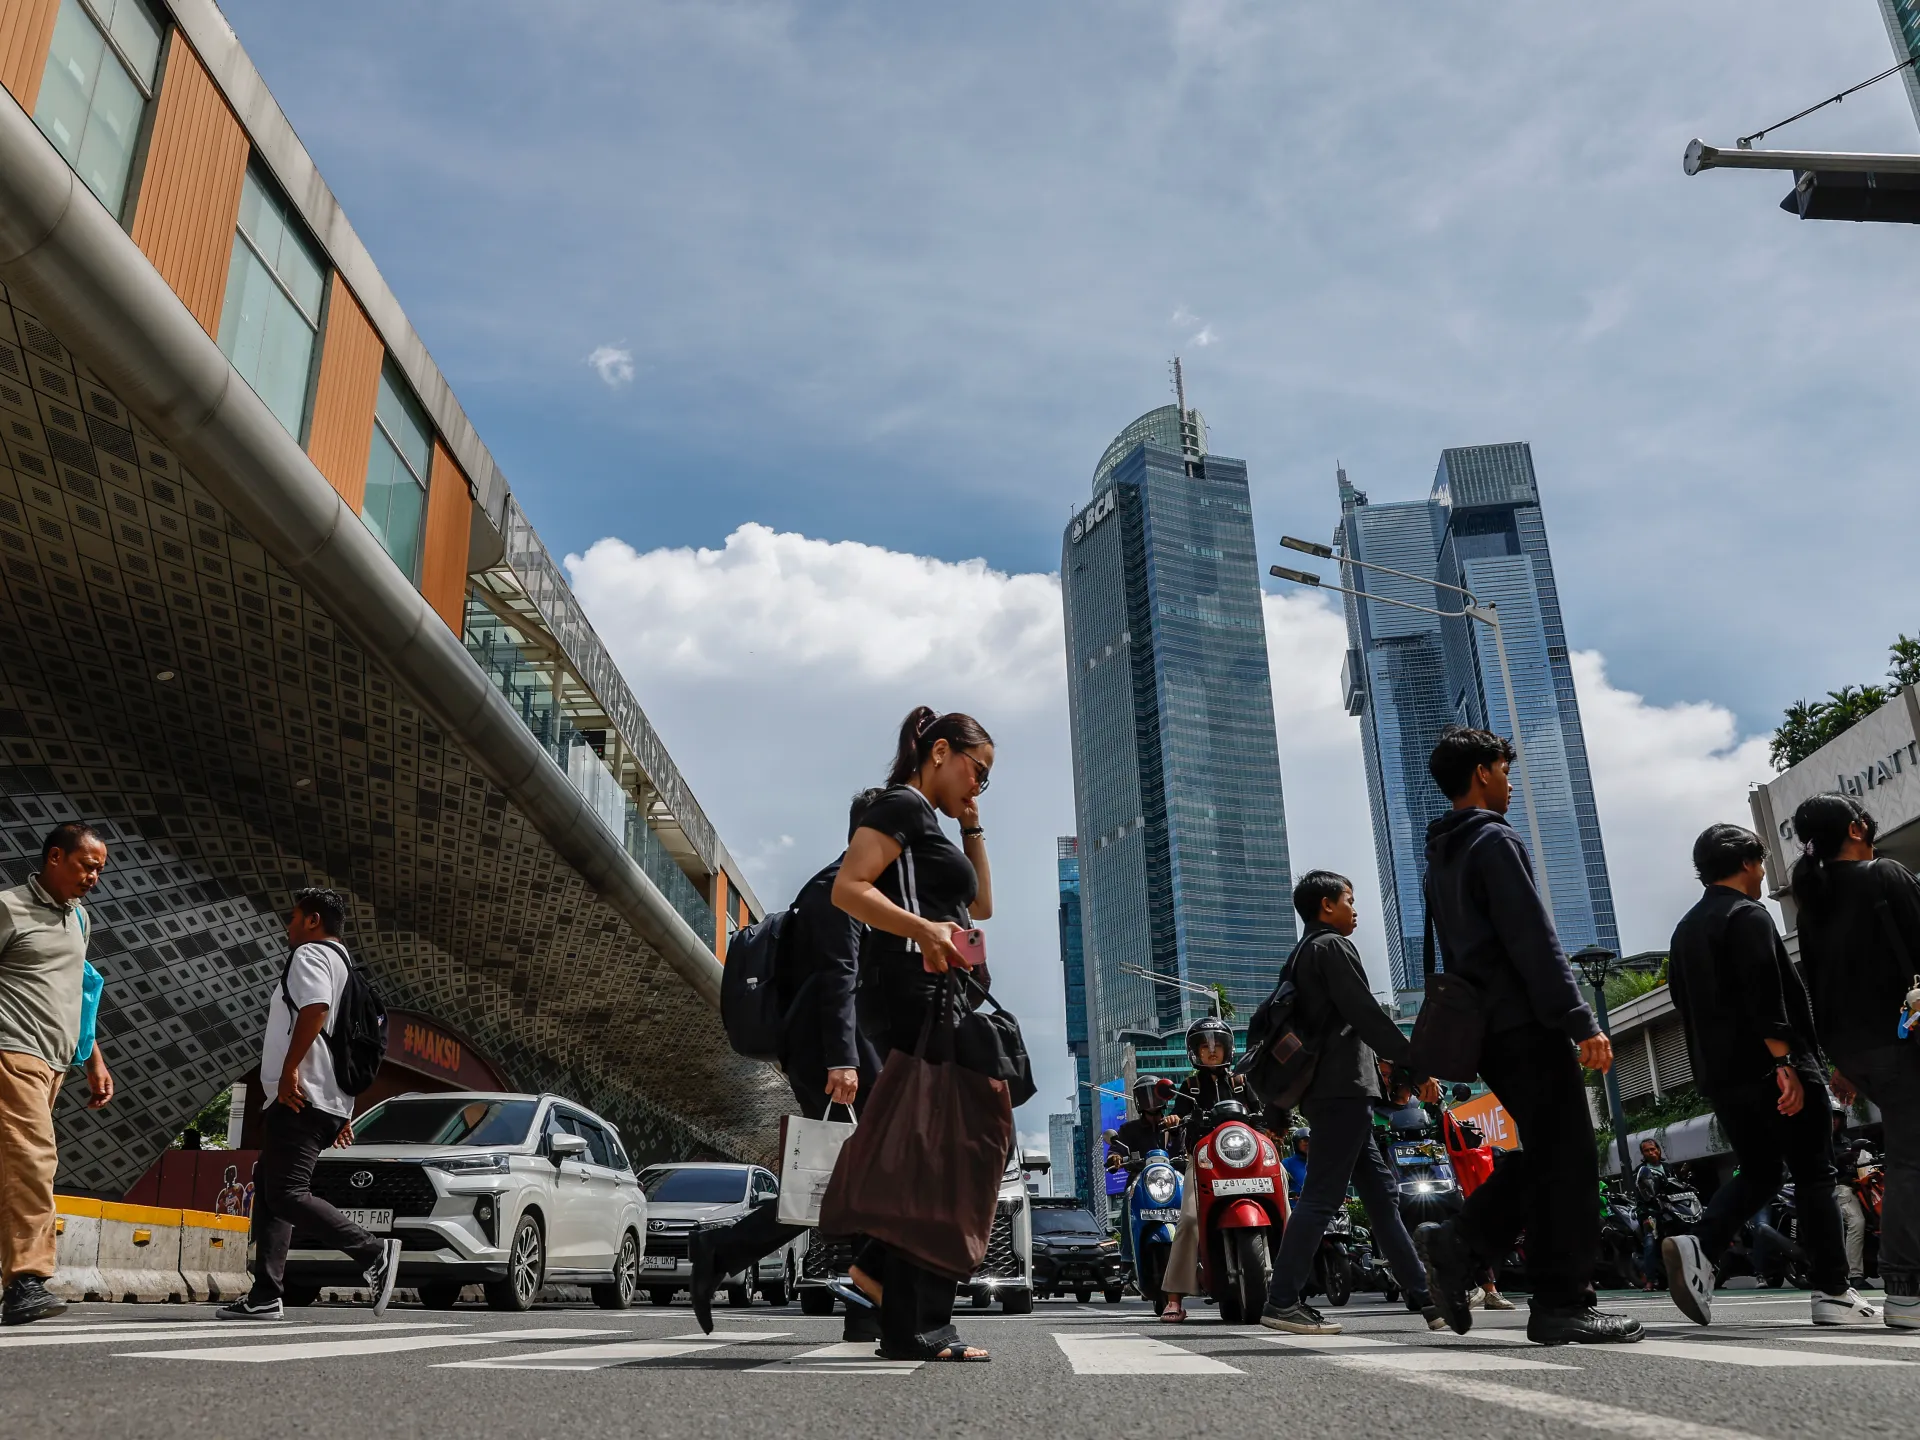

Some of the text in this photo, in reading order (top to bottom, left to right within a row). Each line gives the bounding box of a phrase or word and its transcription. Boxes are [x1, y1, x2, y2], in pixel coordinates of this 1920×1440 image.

[1085, 489, 1114, 533] BCA
[1837, 740, 1918, 797] HYATT
[403, 1023, 460, 1073] #MAKSU
[1213, 1180, 1219, 1188] B
[369, 1210, 391, 1225] FAR
